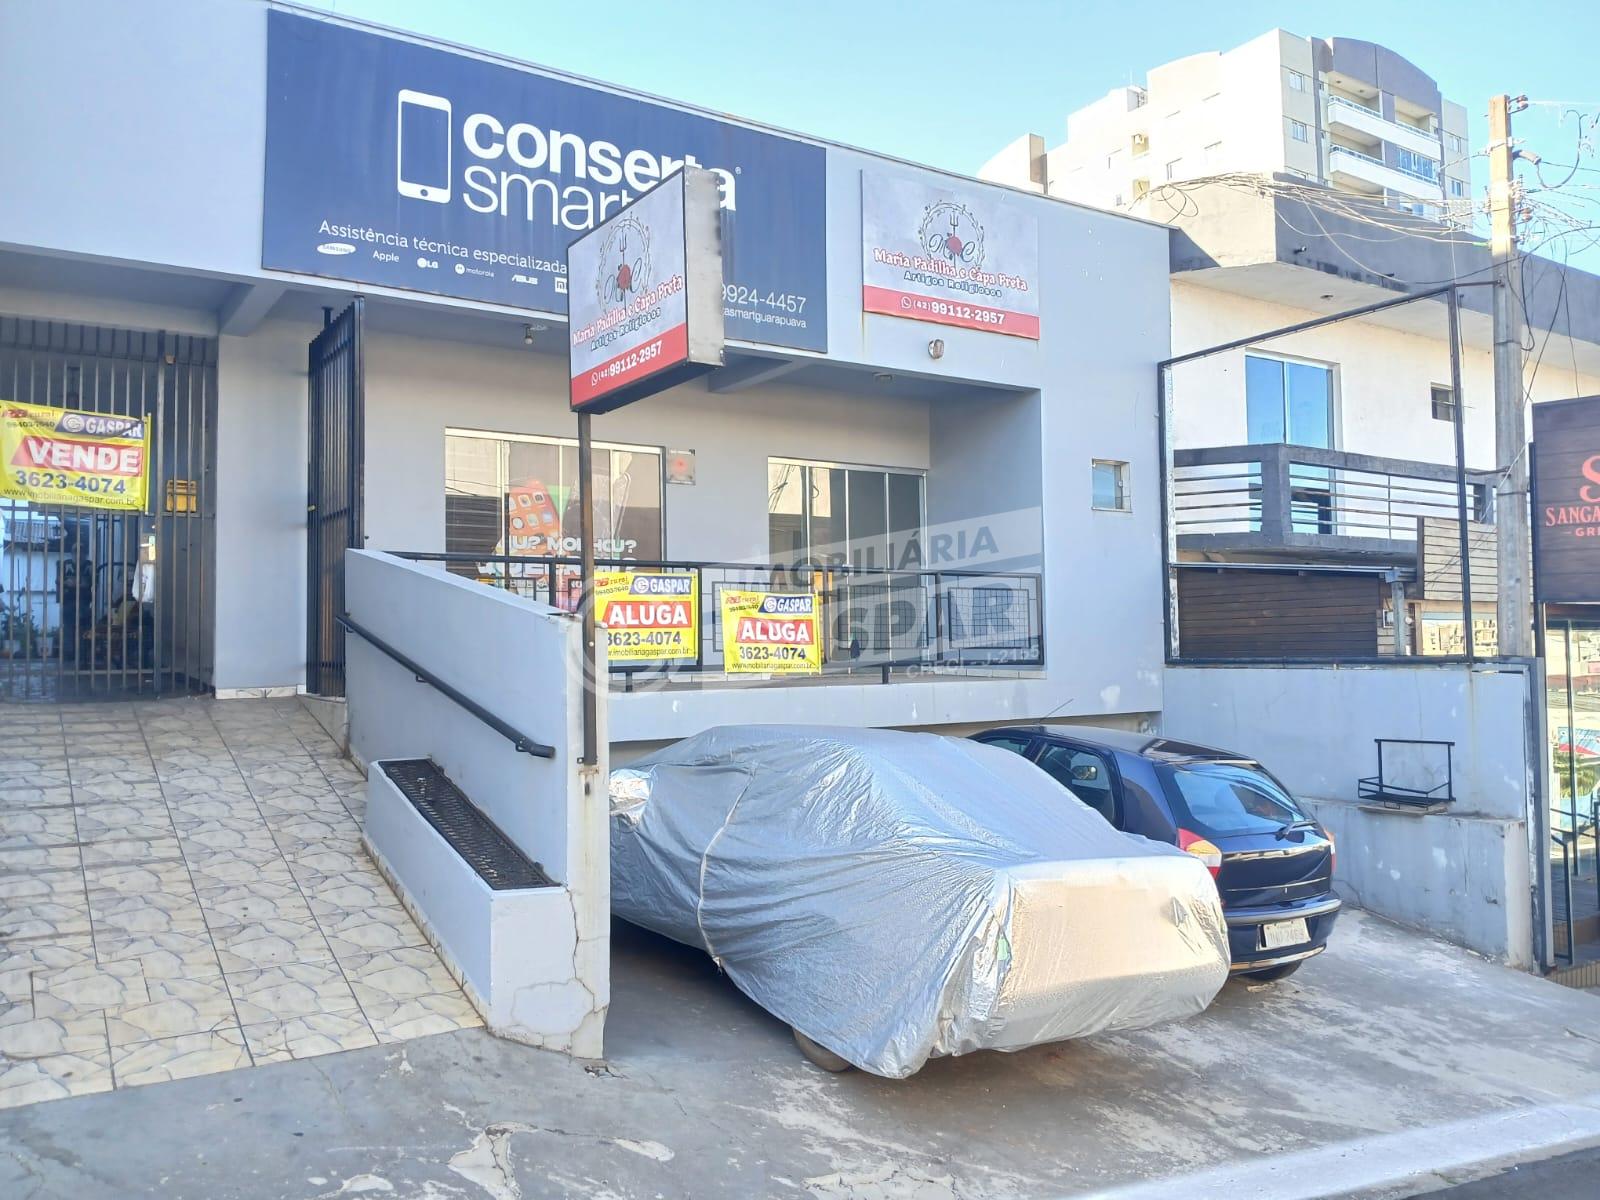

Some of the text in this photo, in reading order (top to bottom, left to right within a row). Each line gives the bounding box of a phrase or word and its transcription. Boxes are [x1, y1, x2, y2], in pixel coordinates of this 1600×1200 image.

[463, 113, 736, 211] consera
[319, 220, 567, 274] Assistência técnica especializada
[373, 250, 400, 262] Apple
[873, 248, 911, 269] Maria
[914, 255, 956, 279] Padilha
[969, 266, 996, 287] Capa
[998, 273, 1028, 292] Preta
[904, 271, 1003, 297] Artigos Religiosos
[572, 324, 596, 346] Maria
[596, 306, 627, 333] Padilha
[634, 292, 657, 314] Capa
[27, 438, 140, 473] VENDE
[15, 470, 126, 494] 3623-4074
[650, 578, 690, 594] GASPAR
[609, 604, 689, 625] ALUGA
[777, 598, 812, 613] GASPAR
[740, 621, 811, 641] ALUGA
[740, 646, 807, 660] 3623-4074
